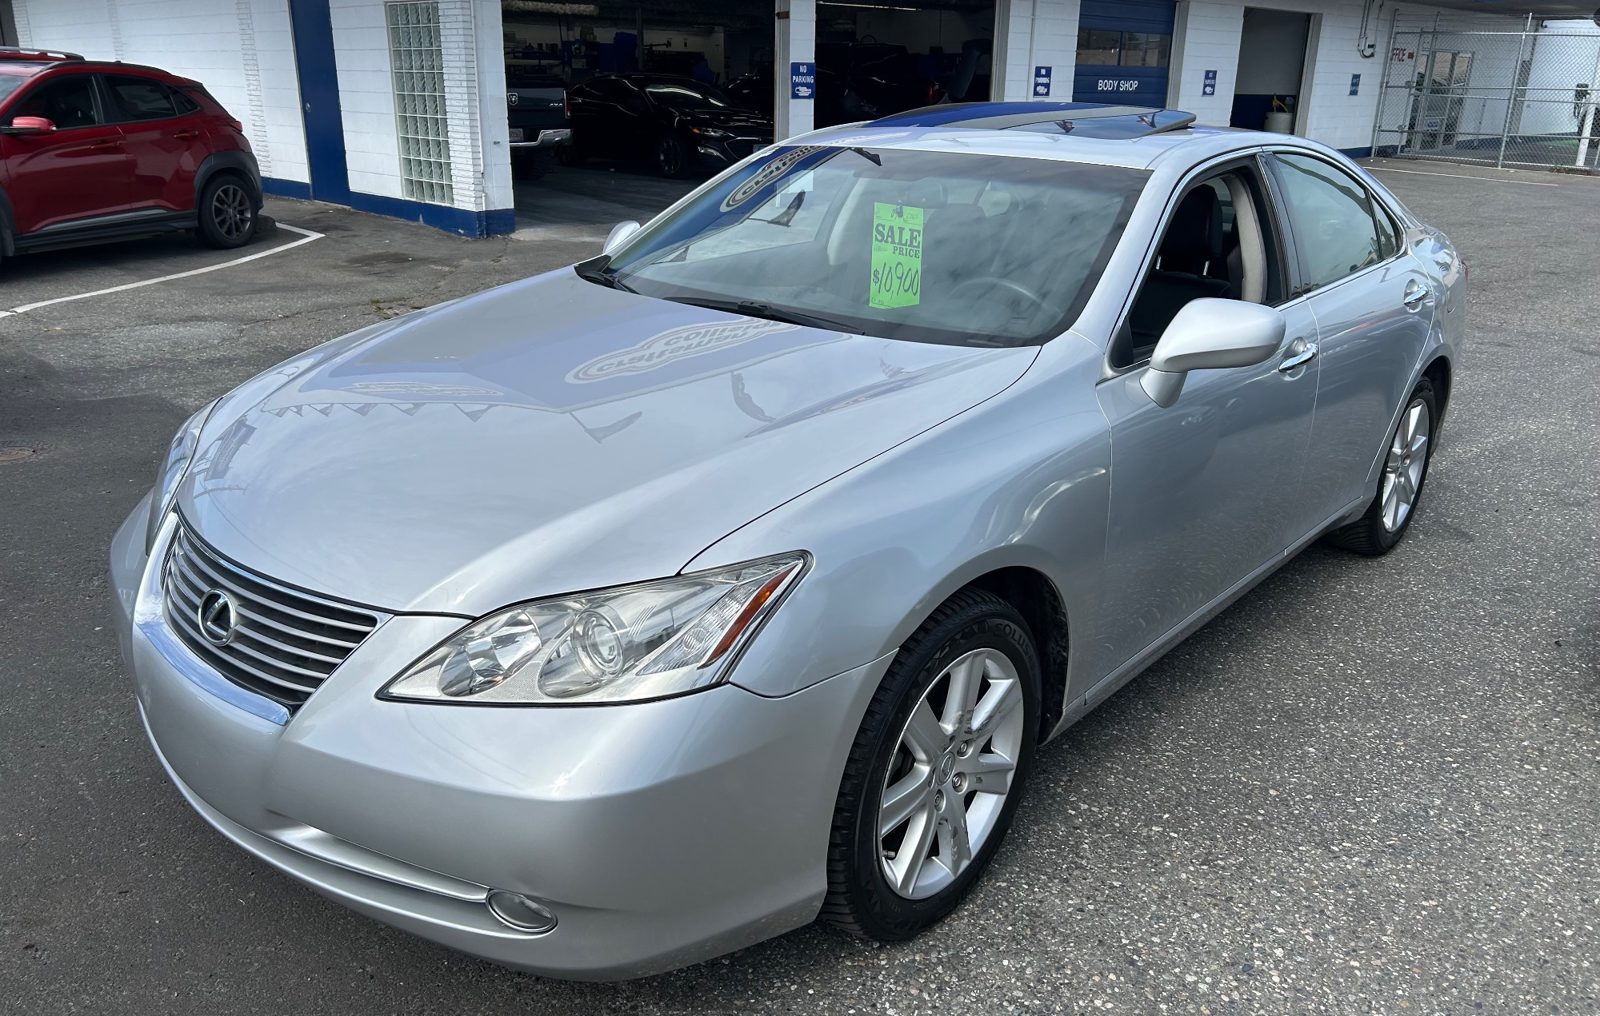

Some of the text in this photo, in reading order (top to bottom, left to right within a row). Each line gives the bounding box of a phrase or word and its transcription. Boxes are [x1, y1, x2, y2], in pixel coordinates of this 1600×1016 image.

[799, 65, 807, 73] NO
[792, 75, 814, 83] PARKING
[1097, 79, 1139, 91] BODY SHOP
[874, 223, 922, 249] SALE
[892, 245, 921, 259] PRICE
[872, 261, 920, 300] $10,900
